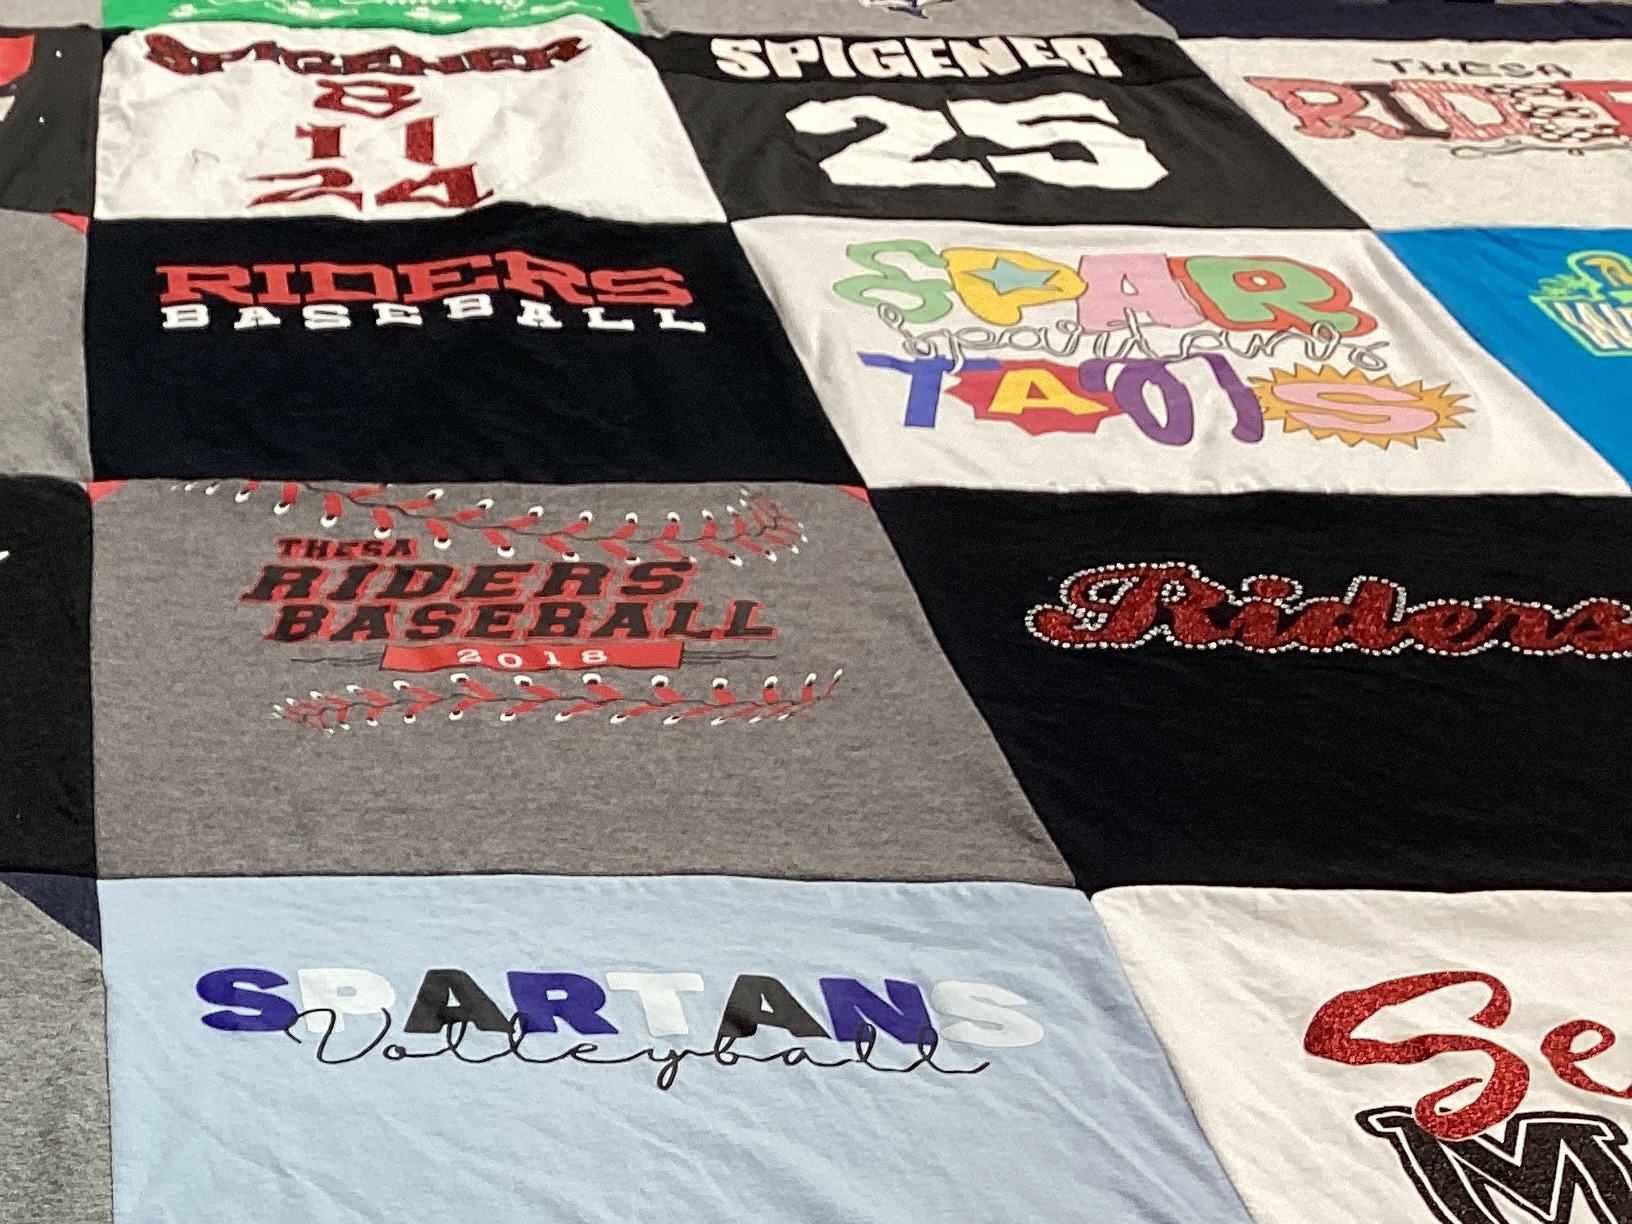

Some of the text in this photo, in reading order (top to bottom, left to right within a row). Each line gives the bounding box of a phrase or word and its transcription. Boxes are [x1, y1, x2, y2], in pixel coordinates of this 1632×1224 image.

[710, 36, 1123, 79] SPIGENER
[785, 92, 1168, 190] 25
[155, 250, 692, 306] RIDERS
[832, 239, 1378, 338] SPAR
[162, 293, 706, 332] BASEBALL
[277, 538, 418, 560] THESA
[242, 561, 700, 602] RIDERS
[264, 599, 778, 641] BASEBALL
[456, 648, 608, 670] 2018
[195, 967, 1046, 1048] SPARTANS
[284, 1007, 990, 1090] Volleyball
